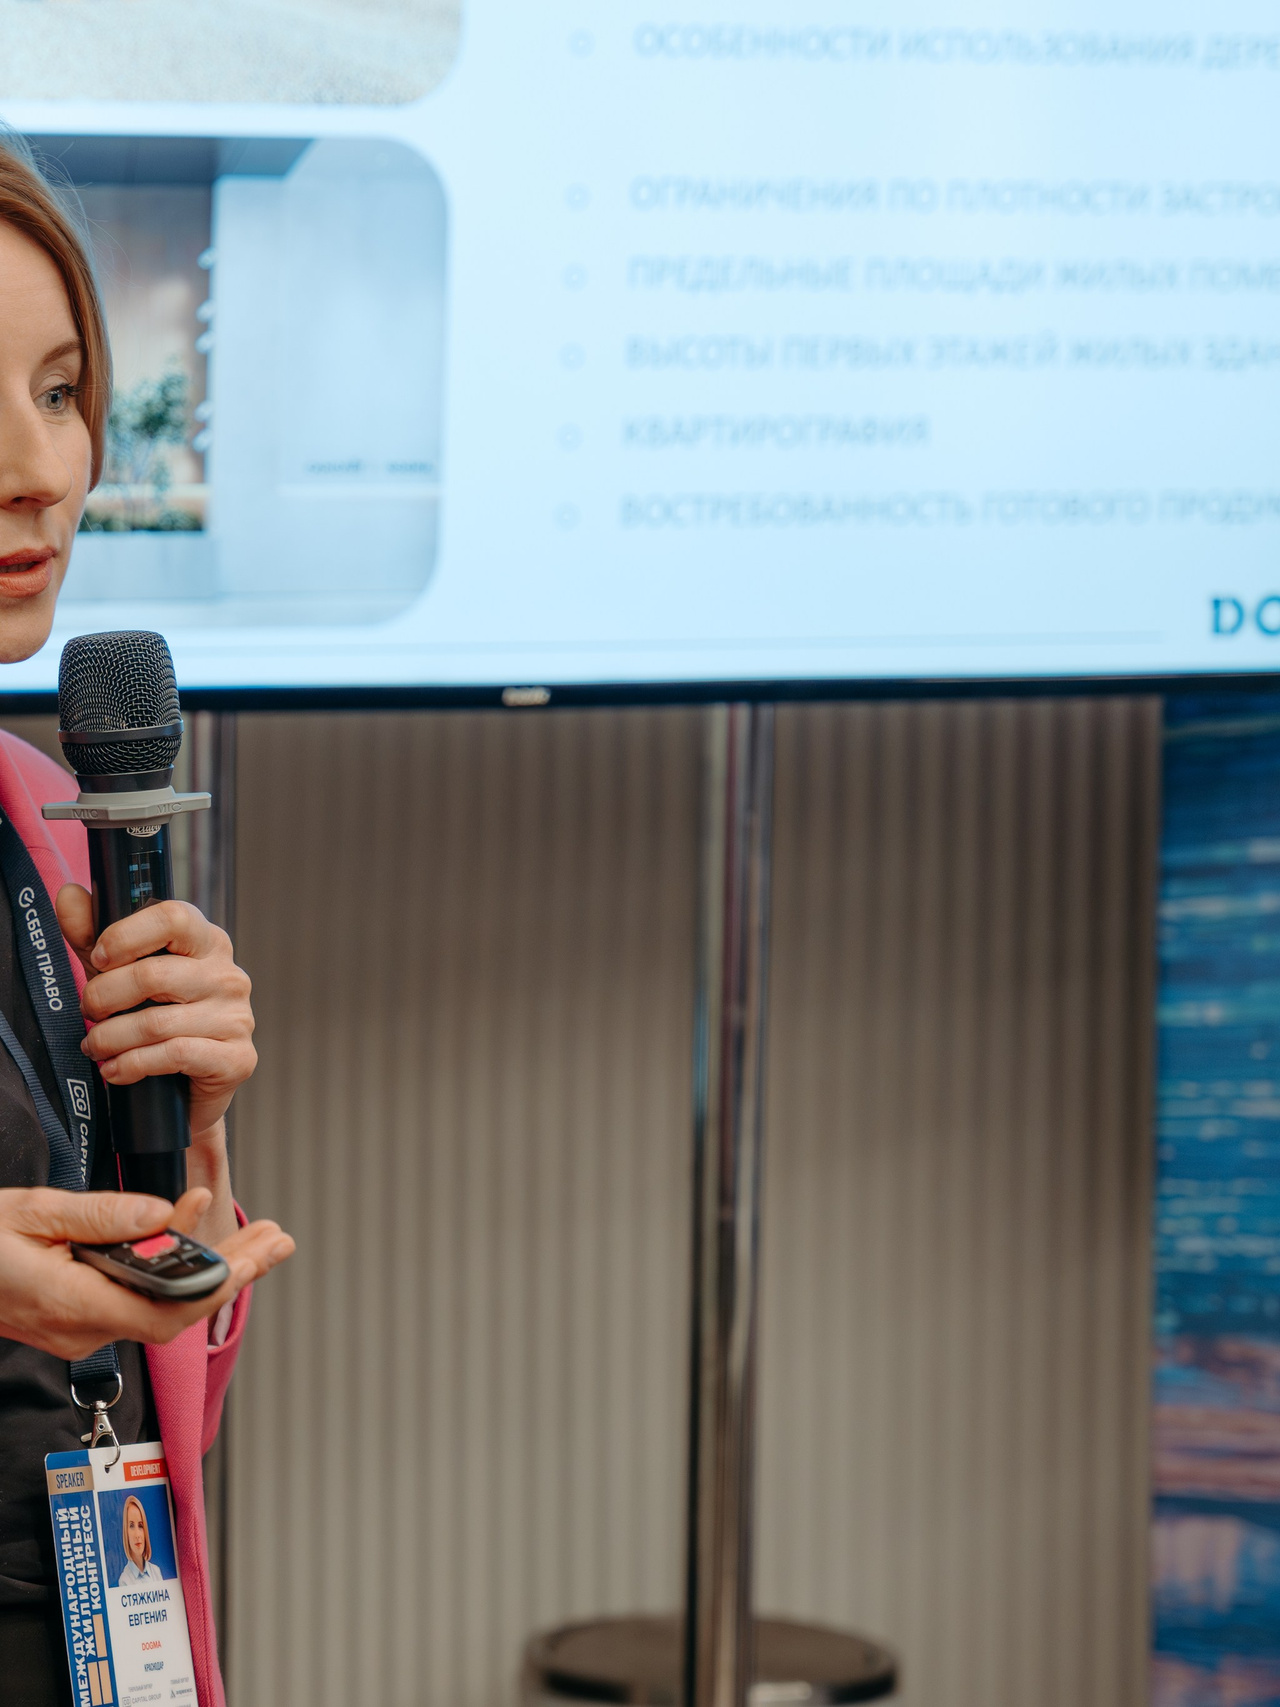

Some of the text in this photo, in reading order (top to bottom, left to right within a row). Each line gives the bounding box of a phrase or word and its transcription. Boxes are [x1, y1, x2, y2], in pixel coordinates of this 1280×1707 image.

[632, 22, 892, 61] ОСОБЕННОСТИ
[898, 28, 1195, 66] ИСПОЛЬЗОВАНИЯ
[629, 175, 880, 212] ОГРАНИЧЕНИЯ
[888, 177, 939, 212] ПО
[947, 179, 1151, 215] ПЛОТНОСТИ
[626, 255, 852, 294] ПРЕДЕЛЬНЫЕ
[865, 257, 1044, 295] ПЛОЩАДИ
[1056, 259, 1179, 292] ЖИЛЫХ
[625, 335, 772, 369] ВЫСОТЫ
[782, 335, 916, 369] ПЕРВЫХ
[930, 332, 1060, 368] ЭТАЖЕЙ
[1067, 336, 1192, 369] ЖИЛЫХ
[622, 413, 930, 449] КВАРТИРОГРАФИЯ
[619, 491, 975, 528] ВОСТРЕБОВАННОСТЬ
[981, 490, 1152, 526] ГОТОВОГО
[72, 808, 99, 819] MIC
[157, 802, 183, 813] MIC
[25, 908, 63, 1011] СБЕР ПРАВО
[73, 1085, 87, 1112] CG
[56, 1471, 85, 1489] SPEAKER
[130, 1462, 161, 1477] DEVELOPMENT
[80, 1504, 102, 1611] КОНГРЕСС
[67, 1506, 97, 1658] ЖИЛИЩНЫЙ
[121, 1588, 171, 1608] СТЯЖКИНА
[56, 1507, 91, 1707] МЕЖДУНАРОДНЫЙ
[128, 1609, 168, 1627] ЕВГЕНИЯ
[141, 1640, 162, 1651] DOGMA
